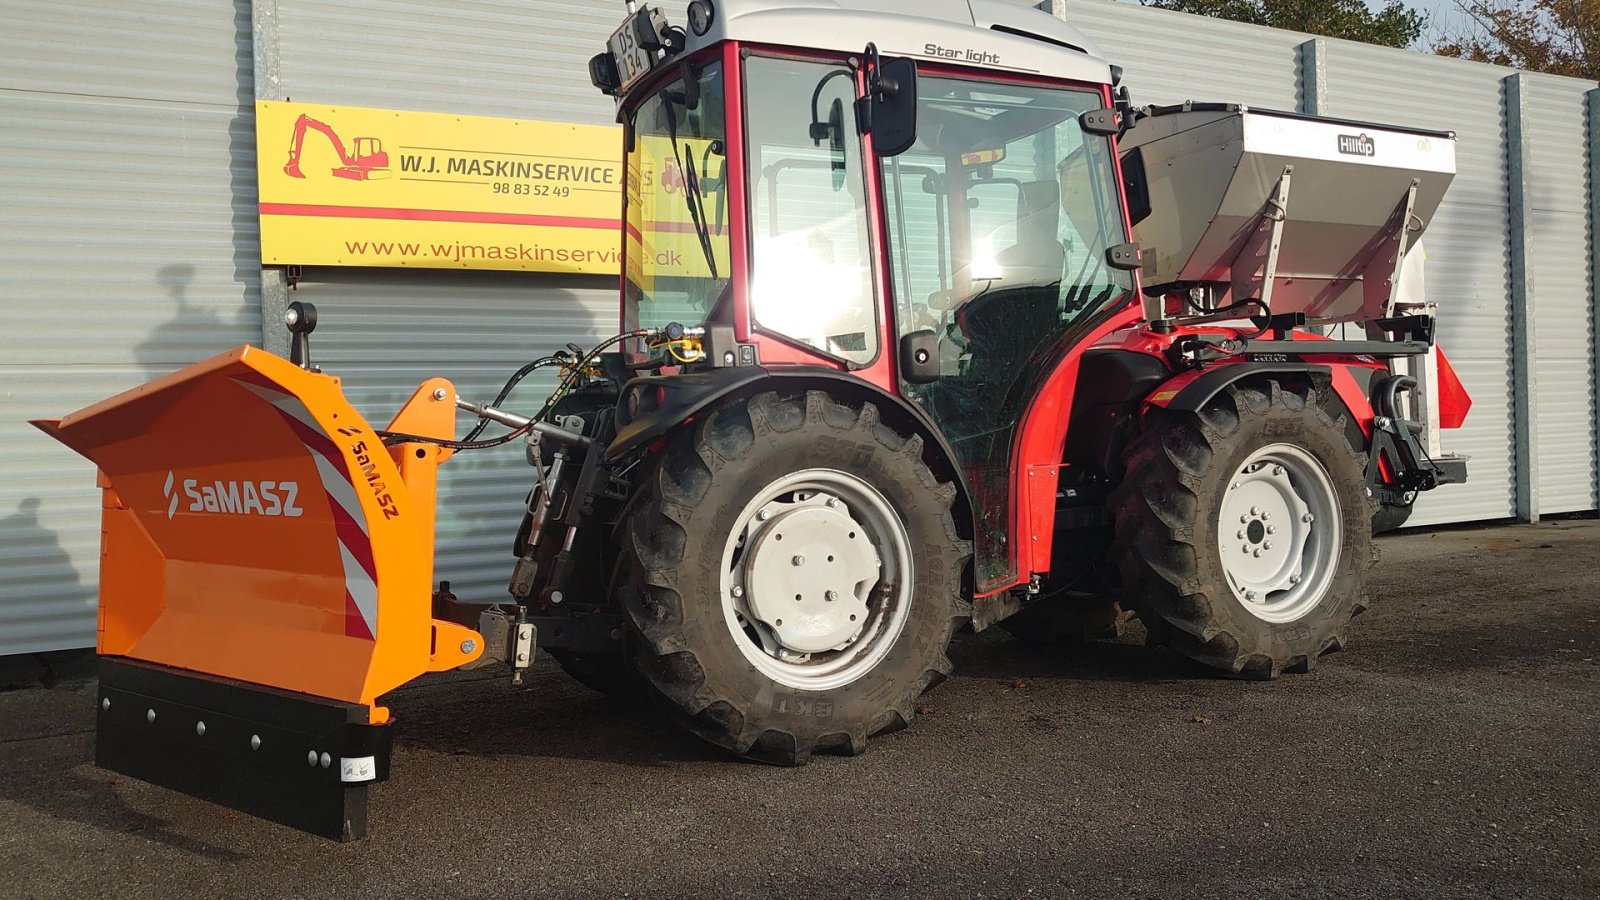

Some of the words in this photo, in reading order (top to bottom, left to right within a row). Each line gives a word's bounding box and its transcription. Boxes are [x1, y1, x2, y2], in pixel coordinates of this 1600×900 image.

[619, 25, 634, 55] DS
[924, 43, 963, 58] Star
[965, 49, 1000, 64] light
[624, 47, 643, 80] 134
[1340, 135, 1373, 157] Hilltip
[400, 154, 440, 174] W.J.
[446, 157, 614, 185] MASKINSERVICE
[493, 182, 510, 194] 98
[513, 183, 530, 195] 83
[533, 184, 549, 196] 52
[553, 186, 570, 198] 49
[351, 440, 399, 520] SaMASZ
[183, 479, 304, 517] SaMASZ
